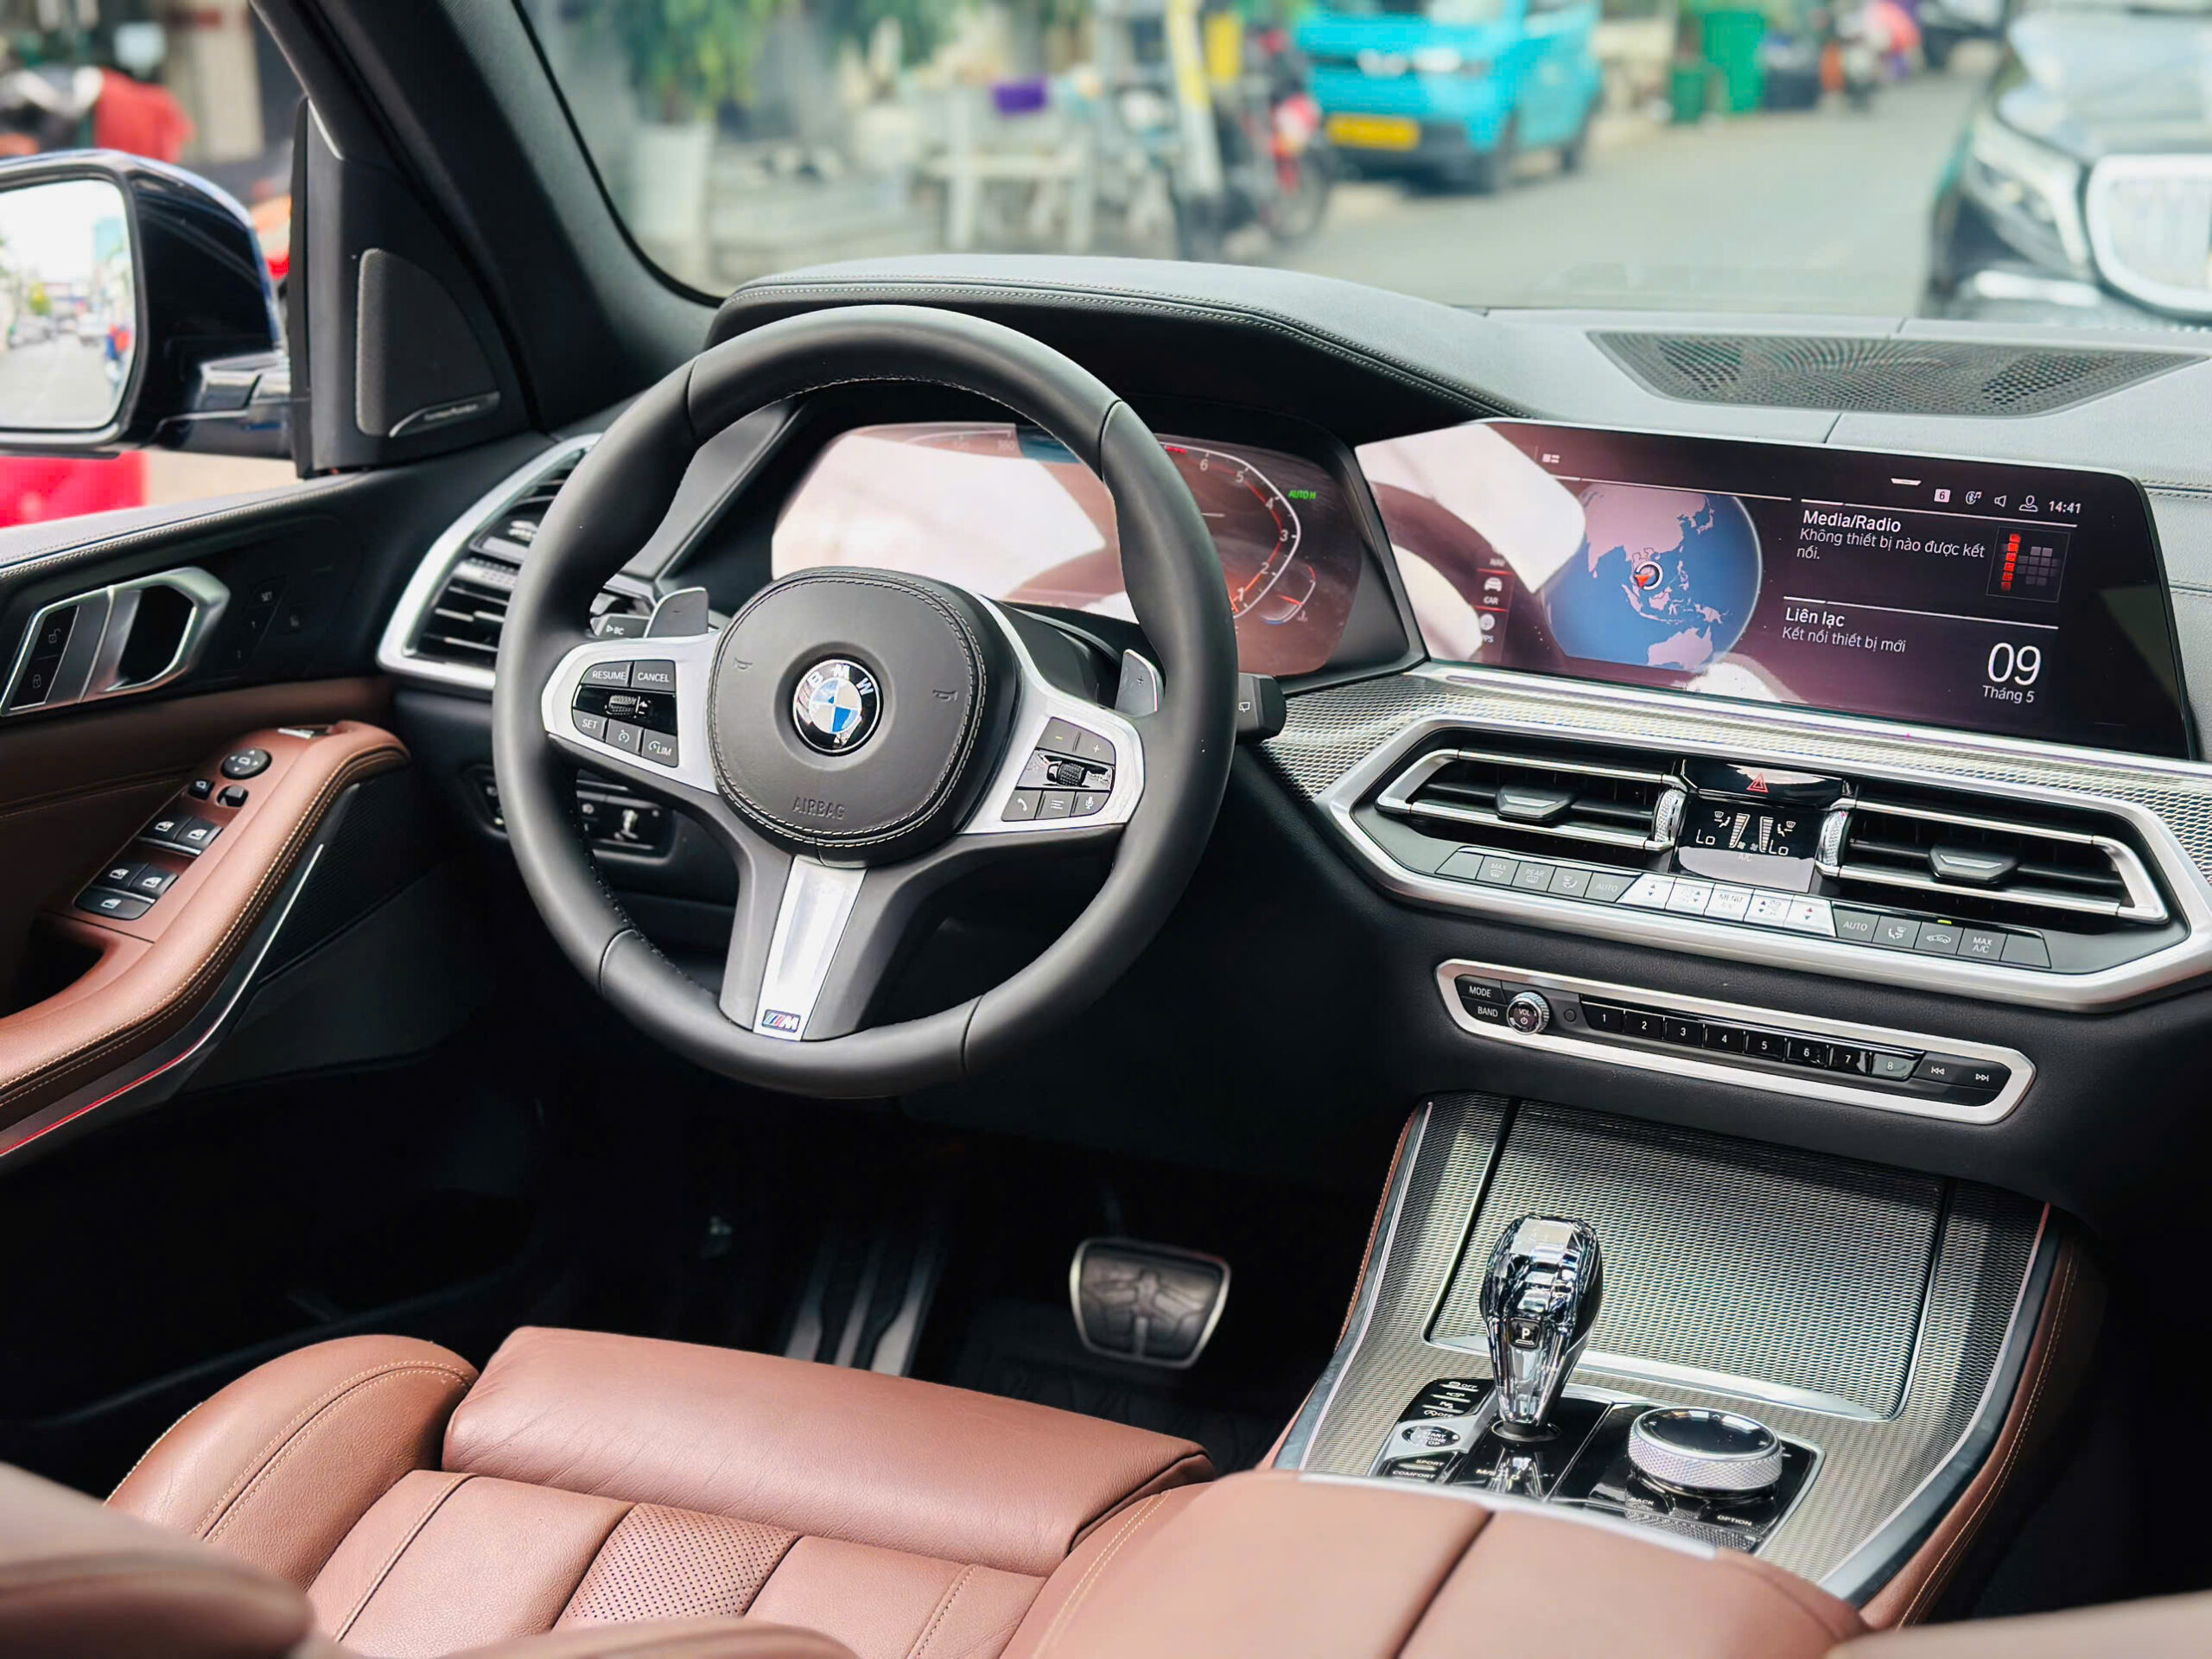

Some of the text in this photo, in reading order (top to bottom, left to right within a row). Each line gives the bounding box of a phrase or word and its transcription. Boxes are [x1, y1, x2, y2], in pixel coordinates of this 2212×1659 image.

[1200, 460, 1208, 471] 6
[1236, 471, 1244, 483] 5
[1288, 490, 1308, 499] AUTO
[1265, 499, 1274, 510] 4
[2049, 500, 2082, 514] 14:41
[1802, 510, 1901, 532] Media/Radio
[1280, 530, 1288, 542] 3
[1800, 528, 1985, 557] Không thiết bị nào được kết
[1796, 545, 1820, 559] nối.
[1261, 562, 1269, 574] 2
[1236, 588, 1244, 601] 1
[1484, 596, 1498, 605] CAR
[1785, 607, 1845, 629] Liên lạc
[614, 626, 625, 636] BC
[1782, 626, 1906, 652] Kết nối thiết bị mới
[1988, 642, 2041, 685] 09
[592, 671, 626, 680] RESUME
[637, 671, 670, 683] CANCEL
[807, 664, 875, 696] BMW
[1982, 684, 2036, 704] Tháng 5
[582, 718, 598, 729] SET
[657, 747, 672, 757] LIM
[792, 796, 847, 821] AIRBAG
[1525, 868, 1545, 877] REAR
[1595, 883, 1618, 893] AUTO
[1842, 920, 1868, 931] AUTO
[1973, 937, 1993, 946] MAX
[1972, 944, 1990, 954] A/C
[1469, 985, 1491, 998] MODE
[1478, 1006, 1498, 1017] BAND
[1522, 1327, 1530, 1339] P
[1392, 1470, 1436, 1479] COMFORT
[1717, 1515, 1752, 1527] OPTION
